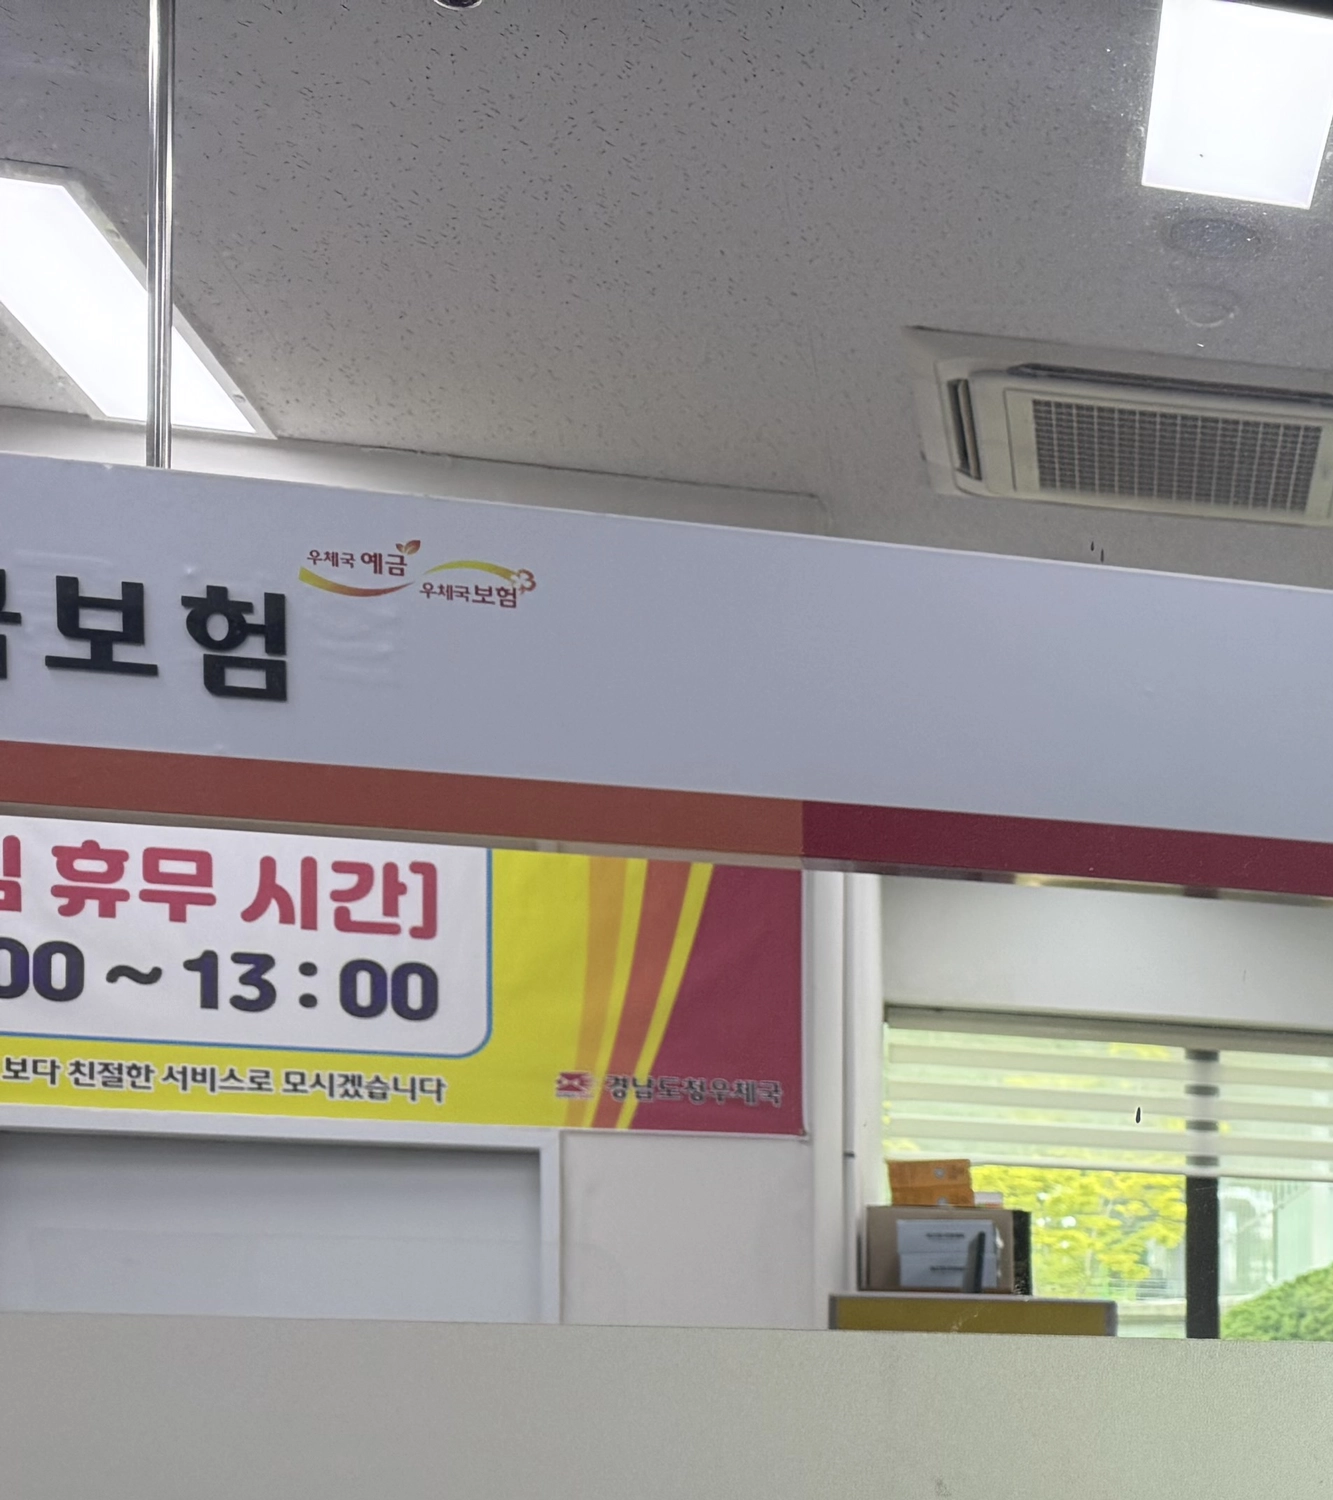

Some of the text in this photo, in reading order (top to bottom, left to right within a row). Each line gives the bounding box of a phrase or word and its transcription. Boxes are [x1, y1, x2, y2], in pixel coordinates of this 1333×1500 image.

[307, 550, 408, 576] 우체국 예금
[0, 569, 287, 702] 보험
[51, 840, 217, 924] 휴무
[240, 855, 438, 940] 시간]
[2, 1055, 447, 1104] 보다 친절한 서비스로 모시겠습니다
[606, 1074, 783, 1108] 경남도청우체국
